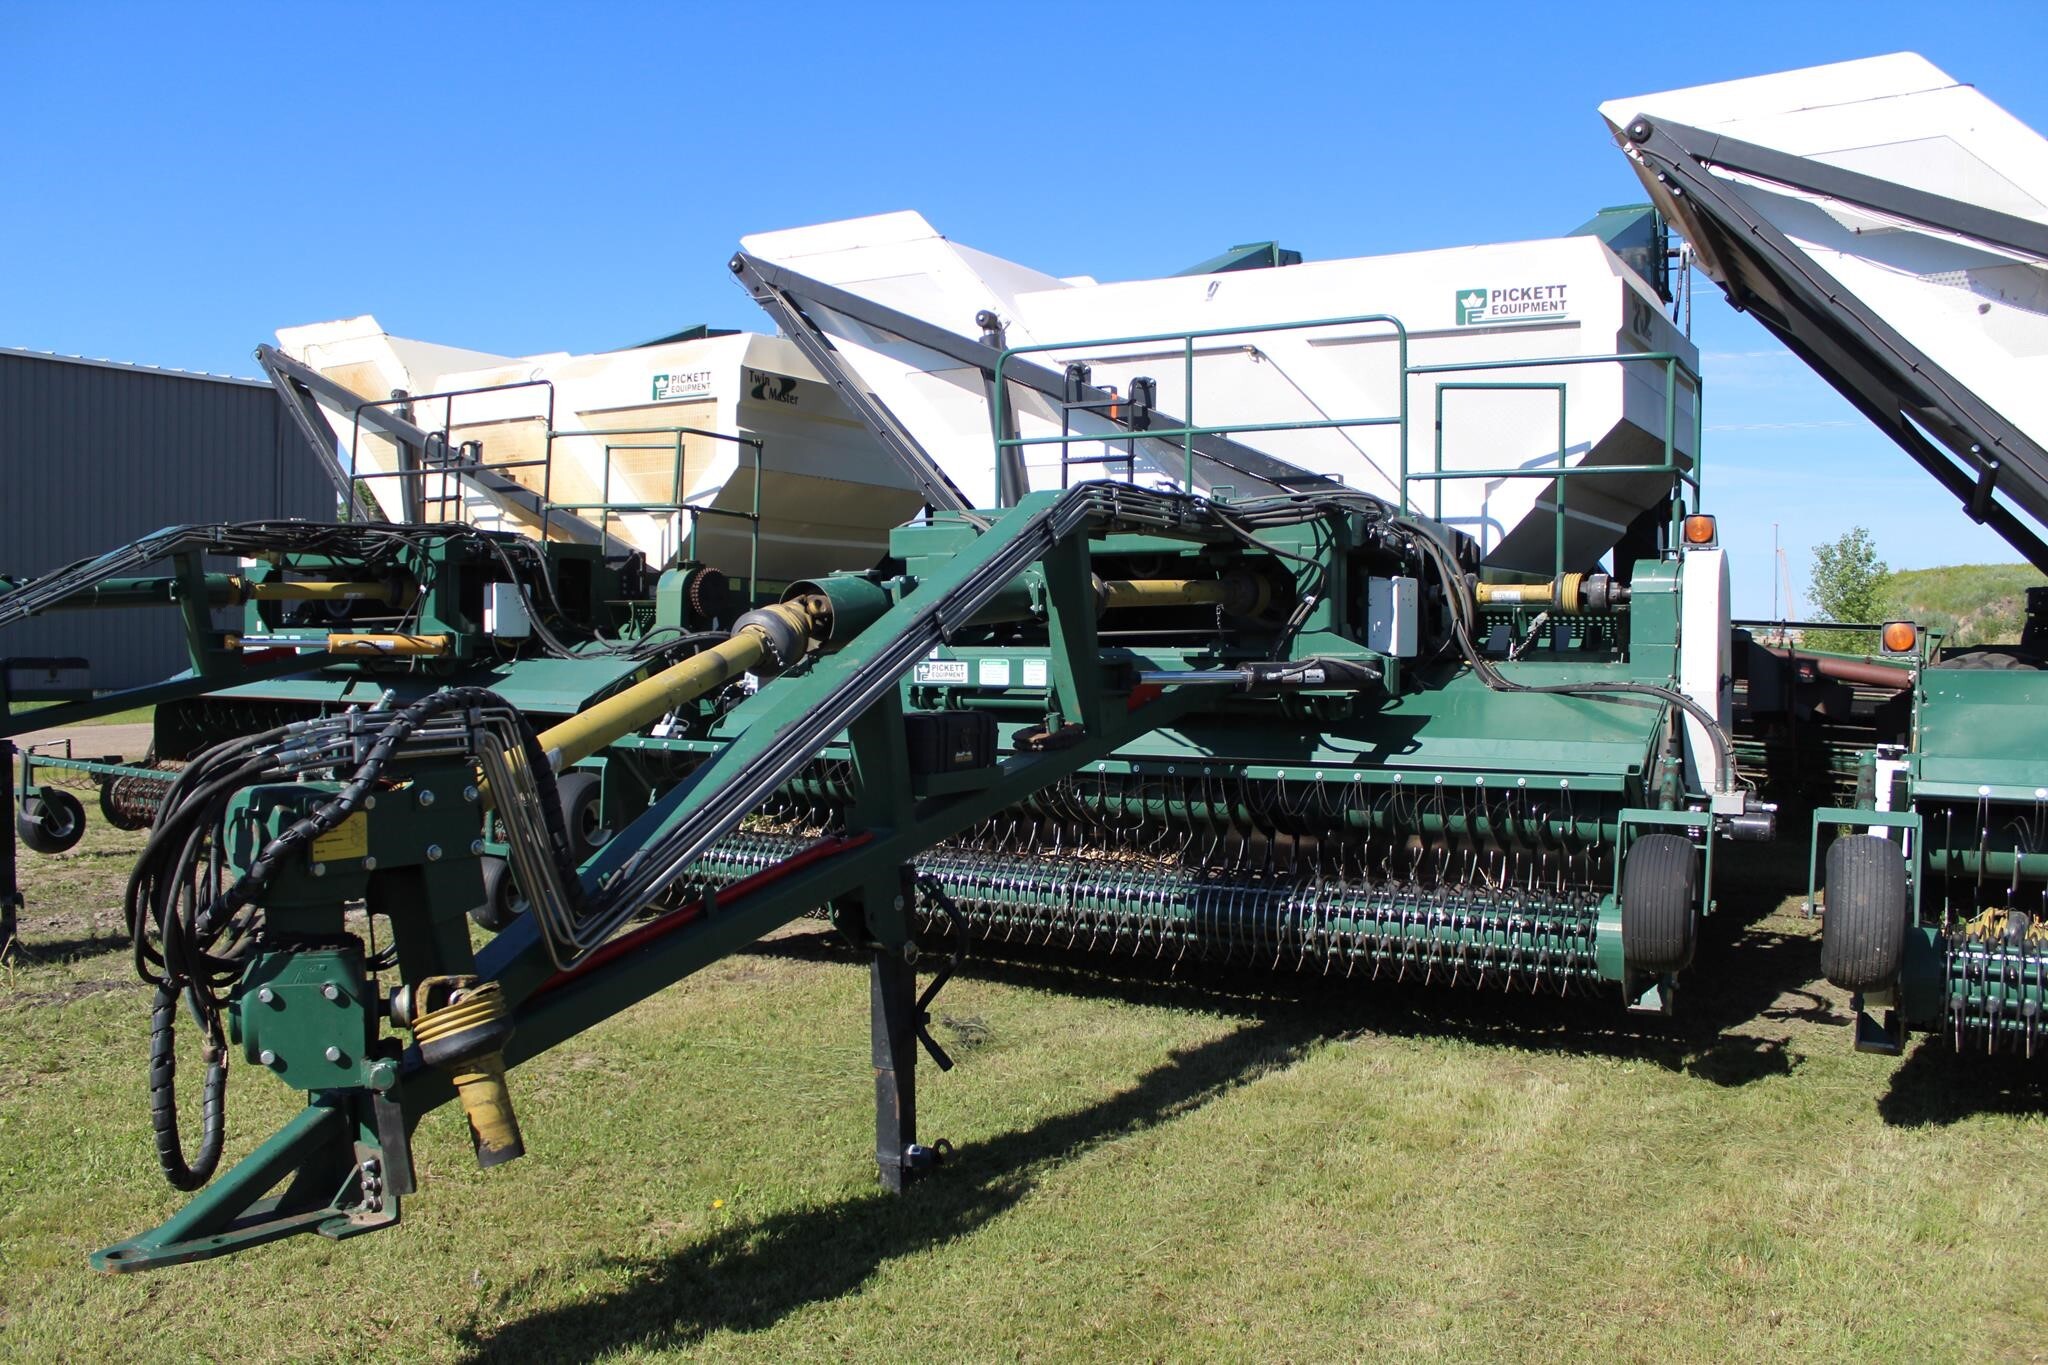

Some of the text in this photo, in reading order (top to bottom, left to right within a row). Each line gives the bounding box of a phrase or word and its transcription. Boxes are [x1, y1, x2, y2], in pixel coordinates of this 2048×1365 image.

[1491, 284, 1567, 303] PICKETT
[1491, 300, 1567, 315] EQUIPMENT
[671, 372, 711, 384] PICKETT
[749, 370, 770, 387] Twin
[671, 382, 711, 394] EQUIPMENT
[768, 387, 799, 405] Master
[931, 664, 965, 672] PICKETT
